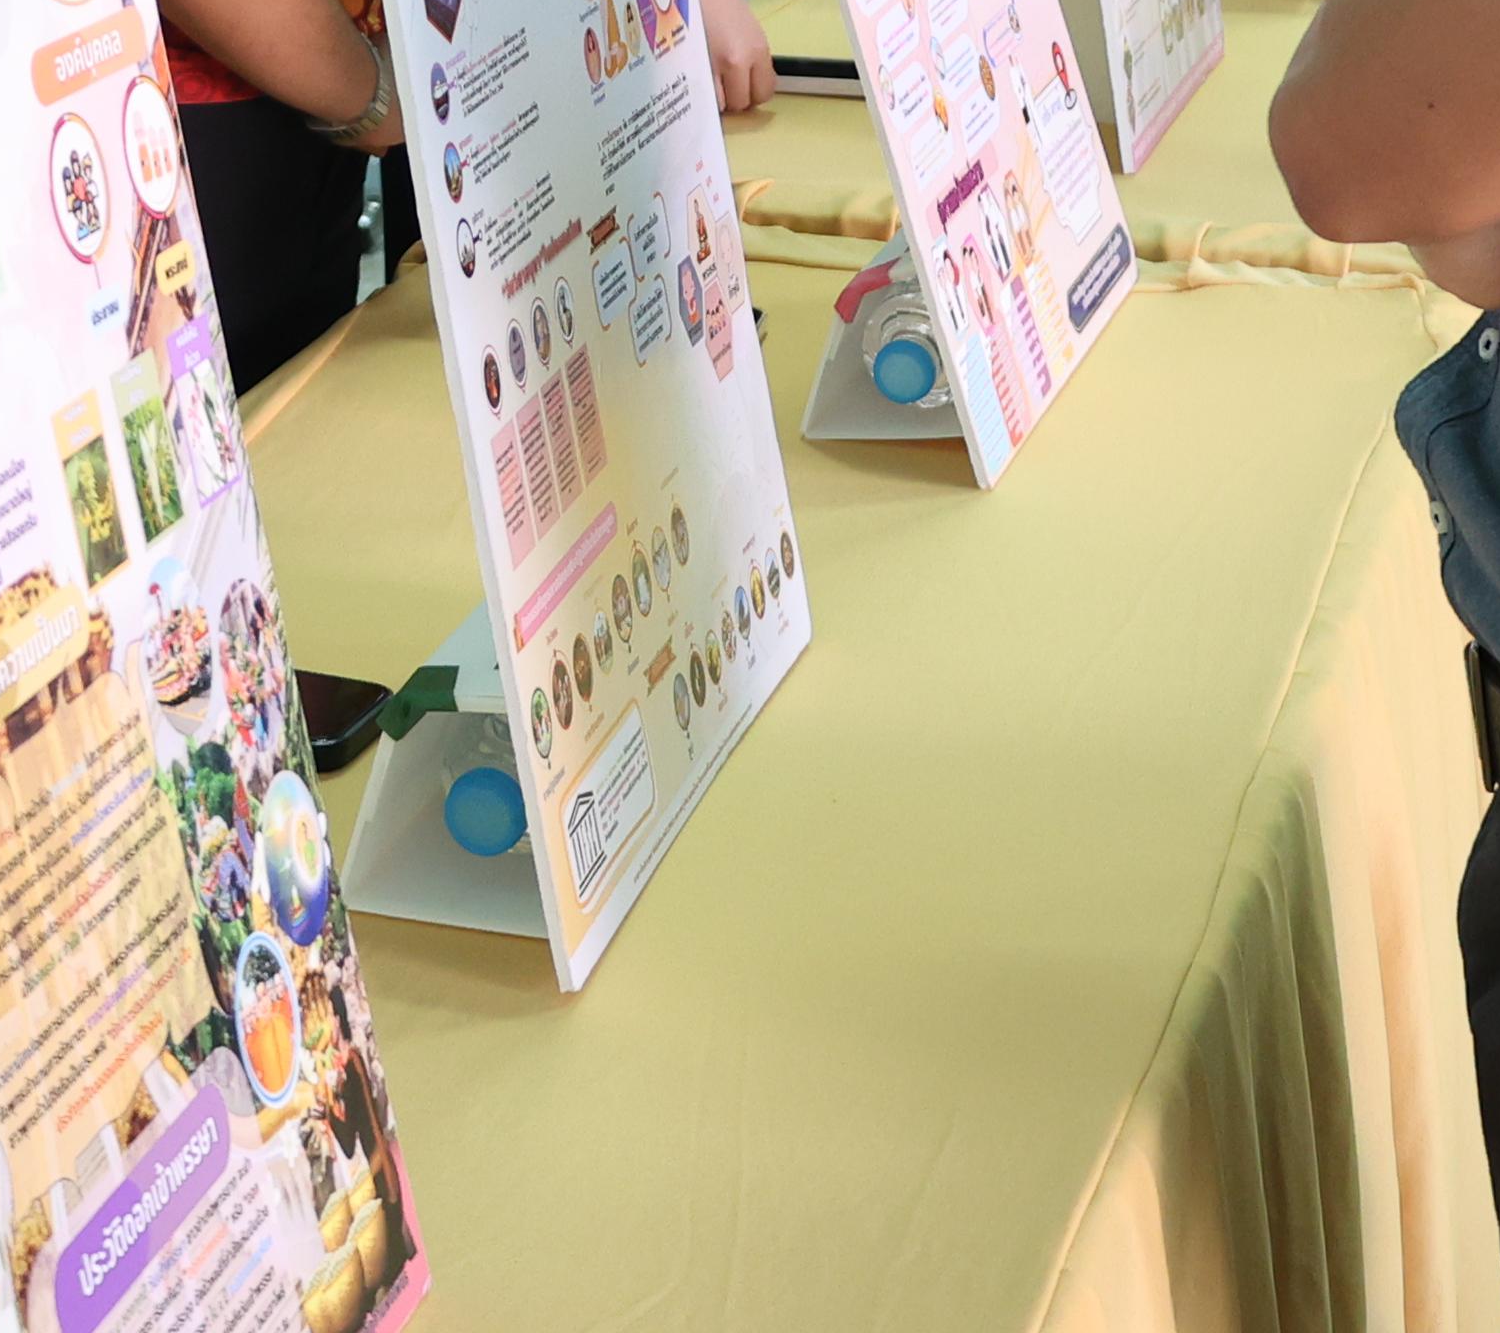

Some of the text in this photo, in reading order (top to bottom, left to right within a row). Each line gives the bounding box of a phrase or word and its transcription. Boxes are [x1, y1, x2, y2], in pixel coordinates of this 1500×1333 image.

[55, 29, 123, 82] องค์บุคคล
[77, 1115, 218, 1298] ประวัติดอกเข้าพรรษา
